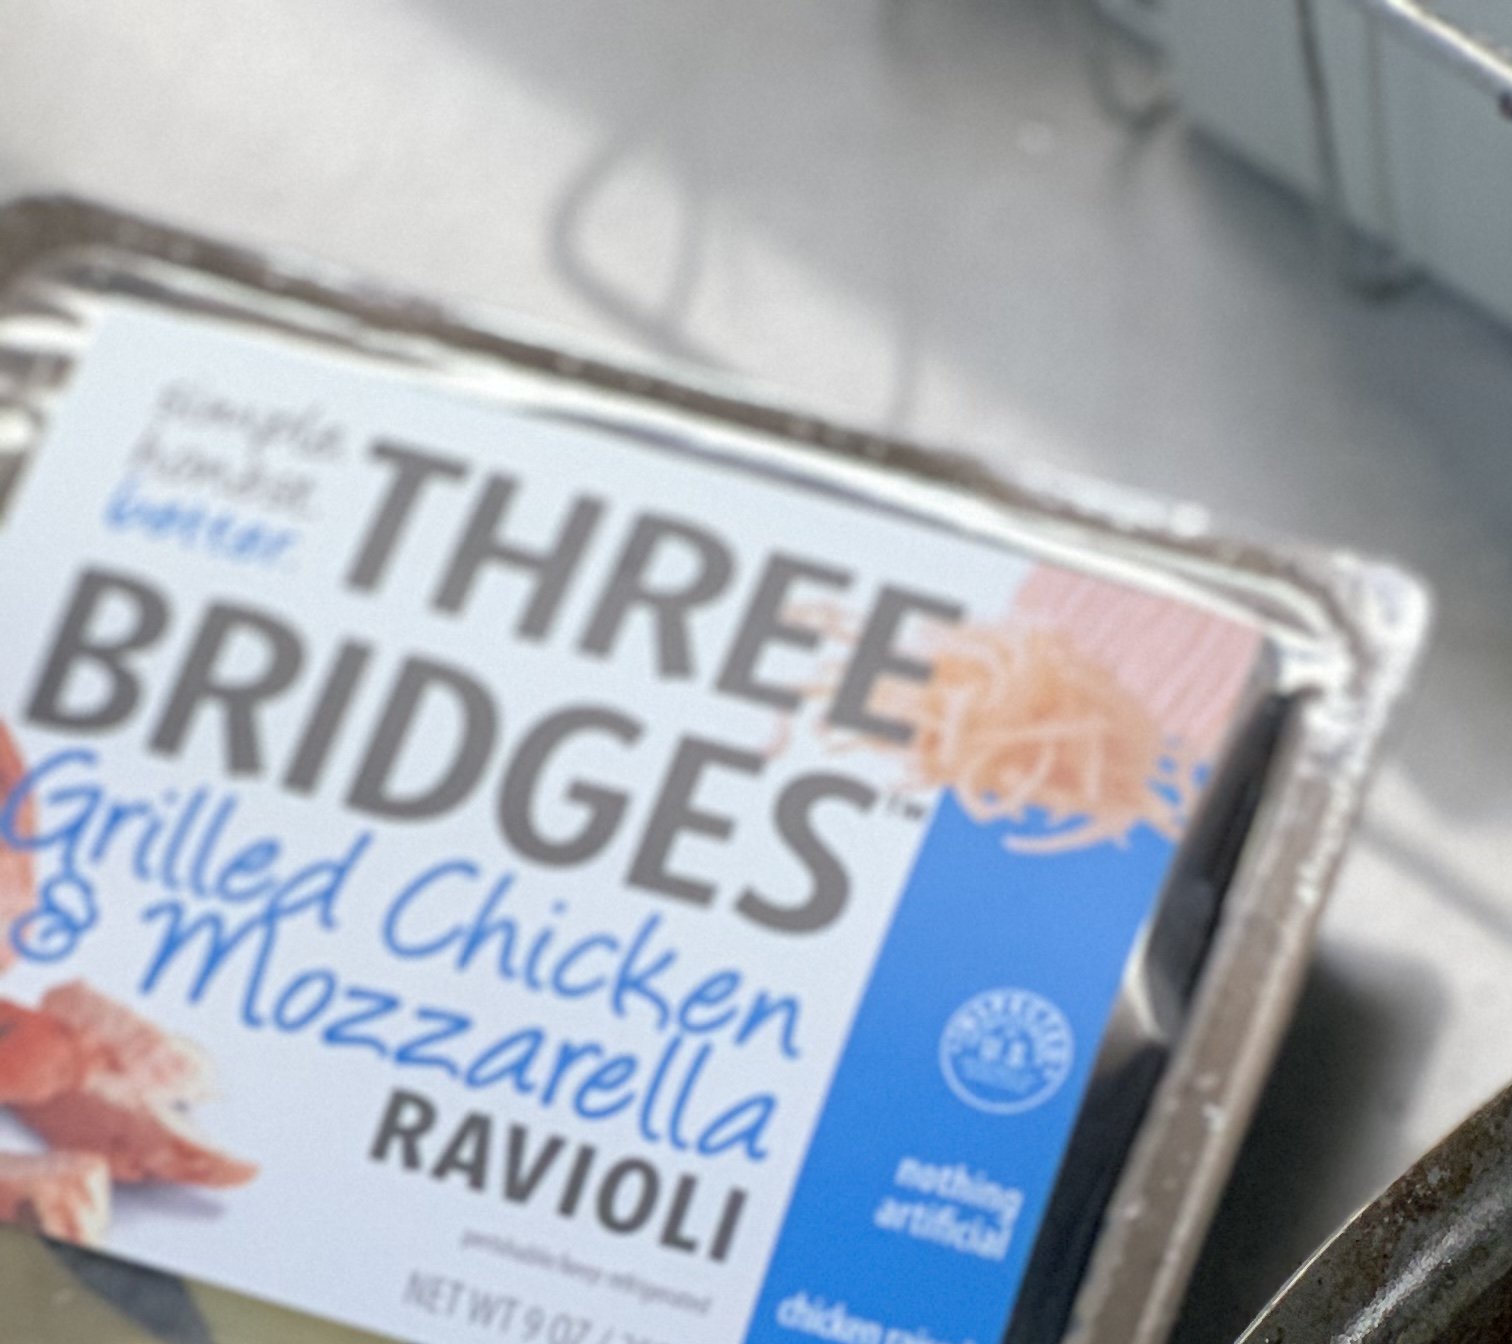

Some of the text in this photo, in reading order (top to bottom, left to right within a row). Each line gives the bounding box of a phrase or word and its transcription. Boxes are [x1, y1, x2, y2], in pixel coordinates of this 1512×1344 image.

[343, 437, 965, 747] THREE
[0, 747, 801, 1060] Grilled Chicken
[139, 898, 778, 1161] Mozzarella
[367, 1087, 748, 1263] RAVIOLI
[873, 1196, 1016, 1263] artificial
[893, 1156, 1024, 1225] nothing
[401, 1269, 465, 1318] NET
[466, 1286, 519, 1334] WT
[521, 1305, 546, 1343] 9
